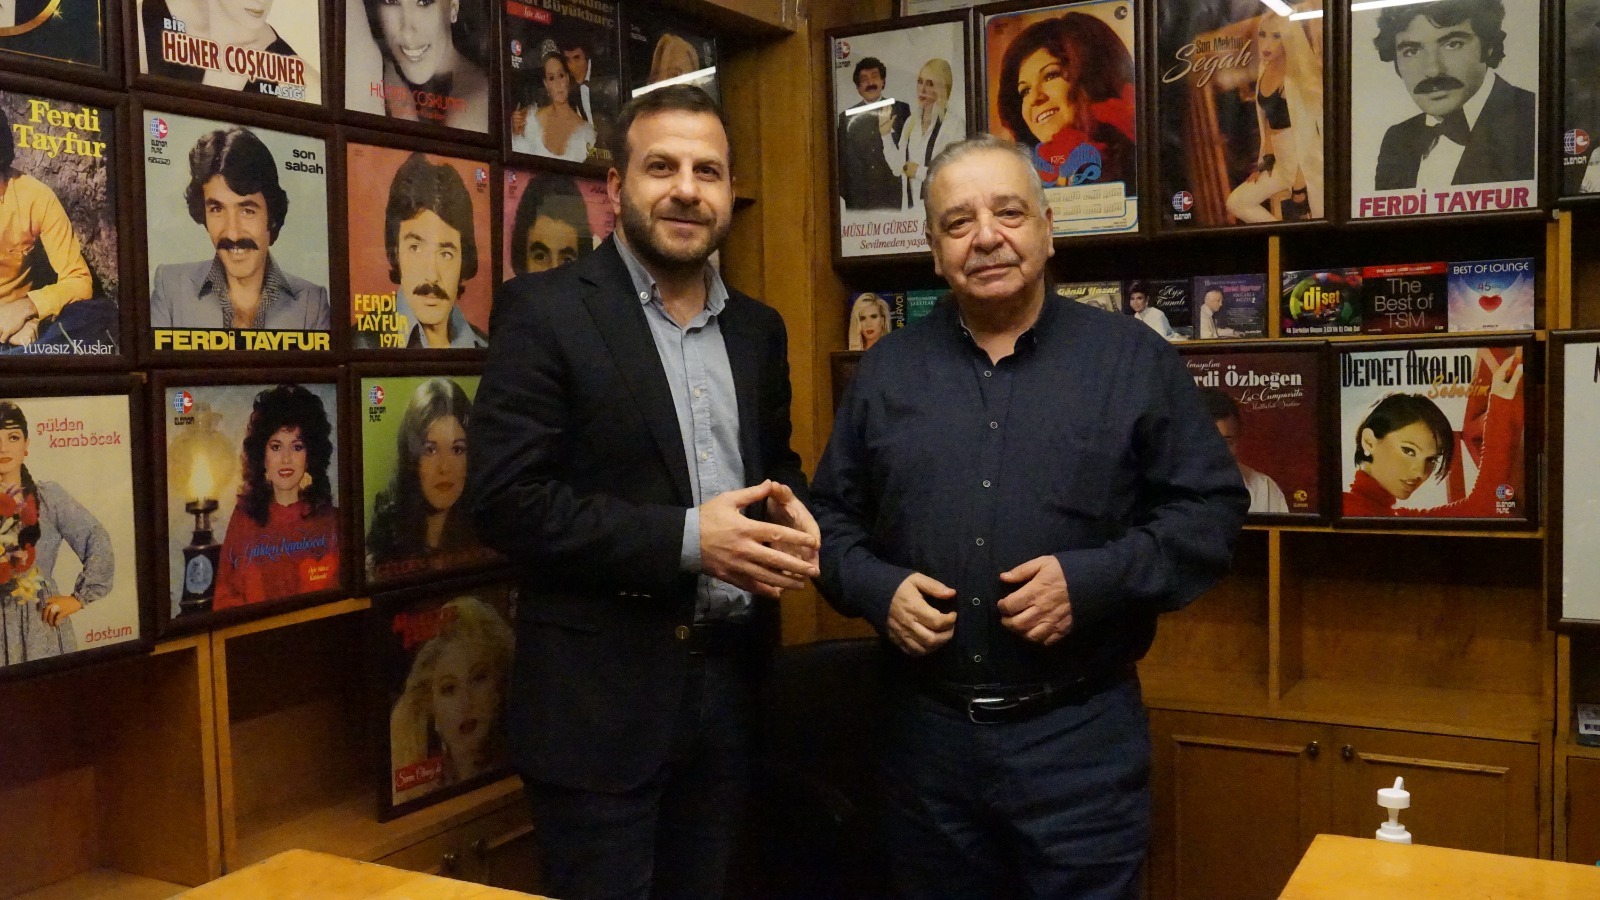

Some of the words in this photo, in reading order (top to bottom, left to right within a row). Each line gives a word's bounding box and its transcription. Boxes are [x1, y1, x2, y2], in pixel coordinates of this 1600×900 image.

[163, 15, 186, 33] BİR
[1196, 40, 1211, 54] Son
[162, 32, 221, 70] HÜNER
[225, 45, 306, 86] COŞKUNER
[1161, 39, 1253, 88] Segah
[28, 99, 101, 133] Ferdi
[13, 123, 107, 159] Tayfur
[292, 147, 316, 161] son
[1050, 154, 1066, 164] 1975
[285, 160, 324, 175] sabah
[1359, 188, 1427, 218] FERDİ
[1434, 186, 1530, 213] TAYFUR
[841, 221, 881, 238] MÜSLÜM
[883, 219, 919, 235] GÜRSES
[860, 237, 906, 250] Sevilmeden
[1453, 265, 1472, 275] BEST
[1474, 264, 1488, 274] OF
[1490, 262, 1529, 273] LOUNGE
[1056, 286, 1086, 296] Gönül
[1386, 278, 1422, 295] The
[354, 290, 397, 315] FERDİ
[1303, 286, 1321, 314] dj
[1321, 290, 1341, 306] set
[1374, 295, 1413, 312] Best
[1417, 293, 1434, 310] of
[355, 312, 410, 334] TAYFUR
[1384, 311, 1425, 329] TSM
[20, 338, 71, 355] Yuvasız
[73, 338, 114, 356] Kuşlar
[154, 330, 236, 351] FERDİ
[241, 331, 331, 351] TAYFUR
[1340, 352, 1404, 388] DEMET
[1405, 349, 1472, 386] AKALIN
[1193, 370, 1220, 387] rdi
[36, 418, 84, 436] gülden
[49, 431, 122, 449] karaböcek
[85, 625, 133, 644] dostum
